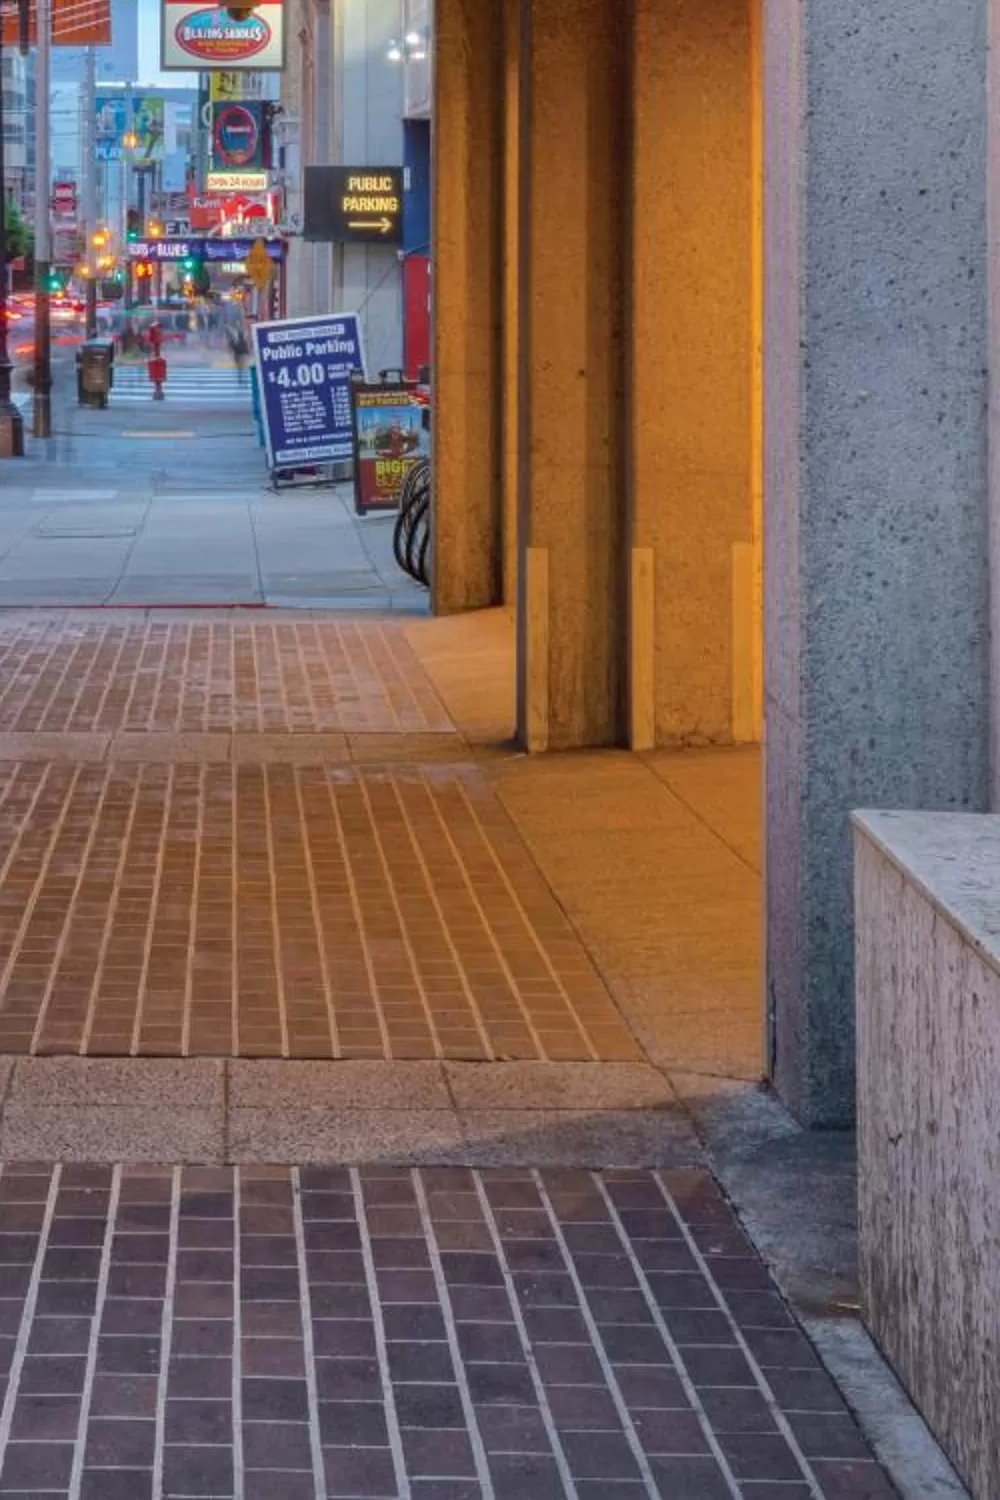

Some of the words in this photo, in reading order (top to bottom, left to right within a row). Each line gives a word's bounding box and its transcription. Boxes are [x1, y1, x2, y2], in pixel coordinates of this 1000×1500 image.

[348, 176, 392, 191] PUBLIC
[343, 197, 398, 212] PARKING
[158, 243, 188, 257] BLUES
[263, 344, 302, 361] Public
[305, 339, 355, 356] Parking
